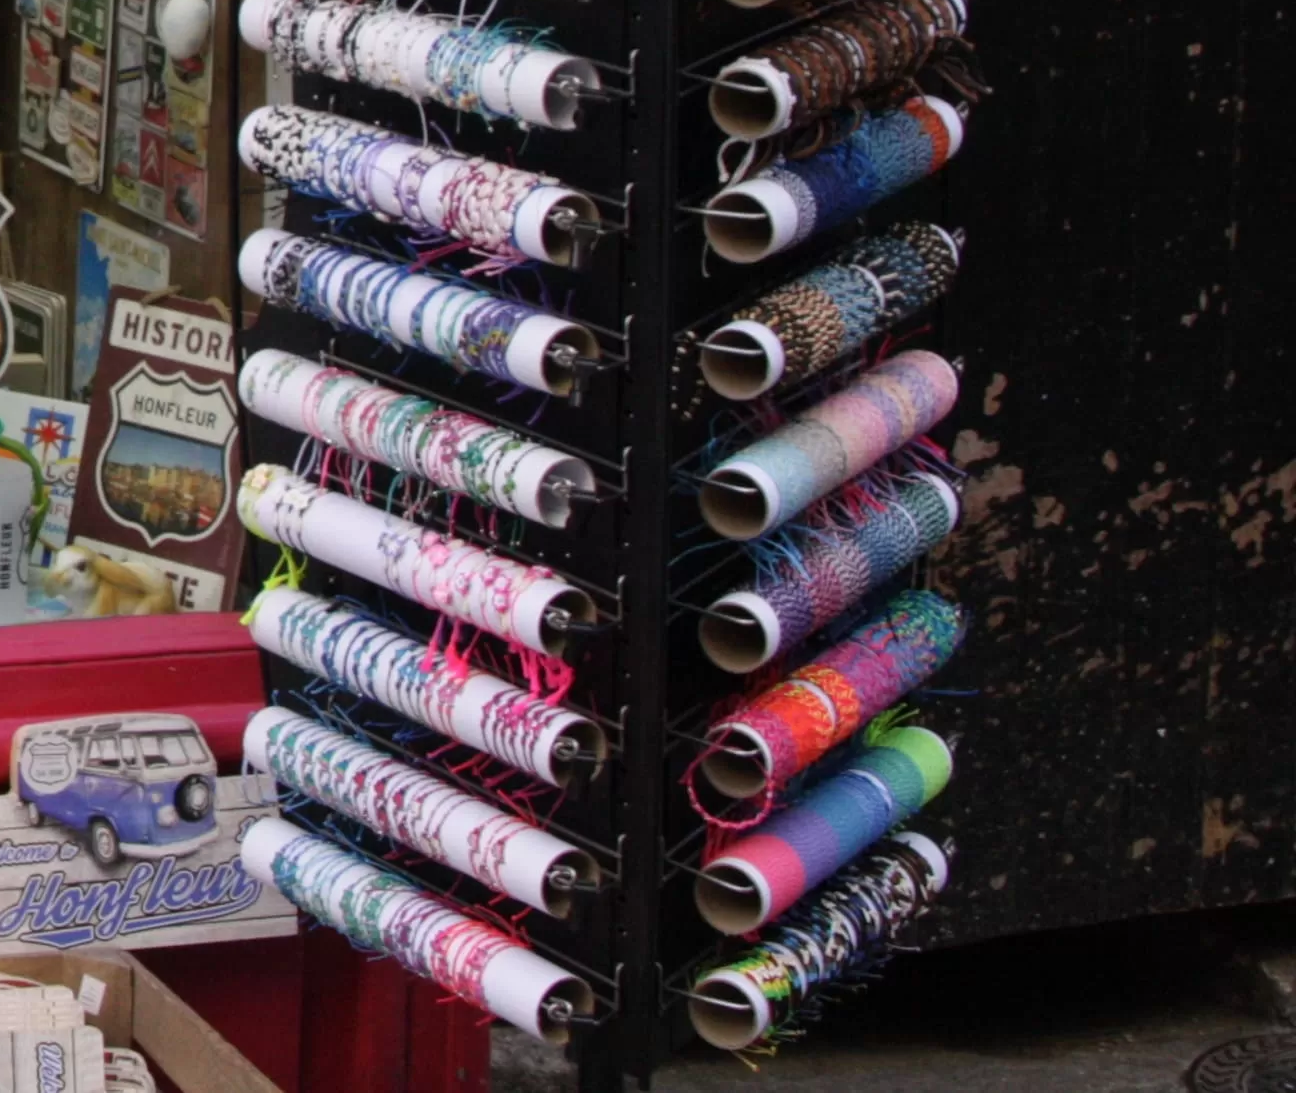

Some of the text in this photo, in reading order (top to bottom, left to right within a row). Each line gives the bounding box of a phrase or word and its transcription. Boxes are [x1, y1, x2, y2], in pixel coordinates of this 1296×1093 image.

[122, 311, 235, 366] HISTORI
[134, 393, 217, 429] HONFLEUR
[0, 522, 13, 589] HONFLEUR
[59, 841, 79, 860] to
